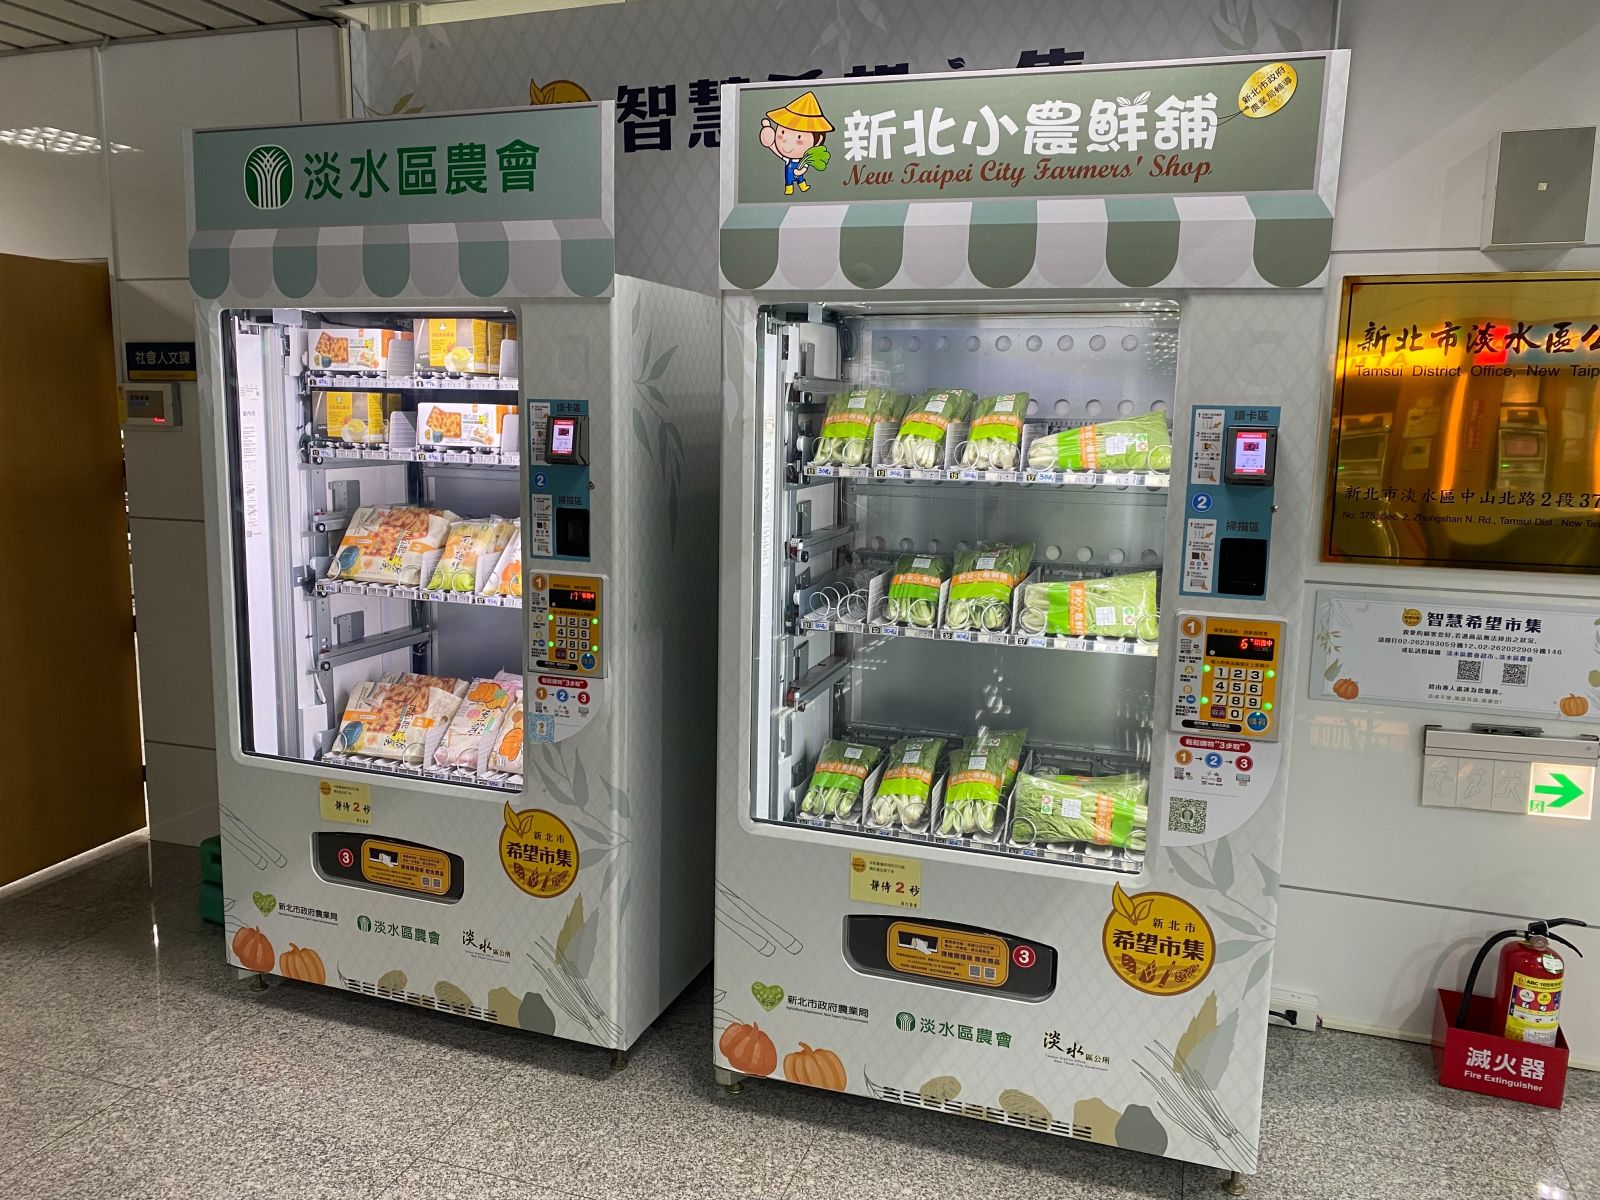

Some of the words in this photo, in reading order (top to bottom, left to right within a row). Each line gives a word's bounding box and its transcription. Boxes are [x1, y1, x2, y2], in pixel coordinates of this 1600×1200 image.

[1242, 66, 1286, 104] 新北市政府
[843, 91, 1218, 162] 新北小農鮮舖
[303, 138, 540, 200] 淡水區農會
[842, 163, 894, 188] New
[899, 161, 975, 191] Taipei
[979, 160, 1027, 188] City
[1033, 154, 1143, 182] Farmers'
[1148, 153, 1213, 184] Shop
[135, 350, 190, 365] 社會人文課
[1356, 365, 1403, 376] Tamsui
[1412, 365, 1461, 377] District
[1470, 364, 1516, 378] Office,
[1526, 364, 1560, 377] New
[537, 476, 544, 486] 2
[1198, 496, 1207, 509] 2
[1226, 521, 1260, 532] 掃描區
[1499, 516, 1532, 526] Tamsui
[1561, 519, 1582, 528] New
[1428, 612, 1543, 634] 智慧希望市集
[1218, 668, 1222, 676] 1
[1234, 670, 1242, 678] 2
[1251, 671, 1259, 679] 3
[1233, 683, 1240, 691] 5
[1216, 695, 1223, 703] 7
[1232, 696, 1240, 704] 8
[1249, 698, 1257, 706] 9
[1231, 710, 1239, 718] 0
[1210, 756, 1218, 765] 2
[1240, 759, 1248, 768] 3
[353, 802, 360, 812] 2
[534, 831, 565, 843] 新北市
[343, 852, 349, 863] 3
[506, 842, 572, 868] 希望市集
[895, 882, 905, 894] 2
[909, 885, 920, 897] 秒
[279, 902, 337, 921] 新北市政府農業局
[373, 920, 440, 946] 淡水區農會
[1152, 918, 1196, 933] 新北市
[1113, 929, 1204, 962] 希望市集
[1019, 950, 1030, 963] 3
[787, 995, 868, 1018] 新北市政府農業局
[919, 1017, 1013, 1050] 淡水區農會
[1466, 1046, 1545, 1080] 滅火器
[1464, 1070, 1481, 1080] Fire
[1484, 1074, 1543, 1092] Extinguisher
